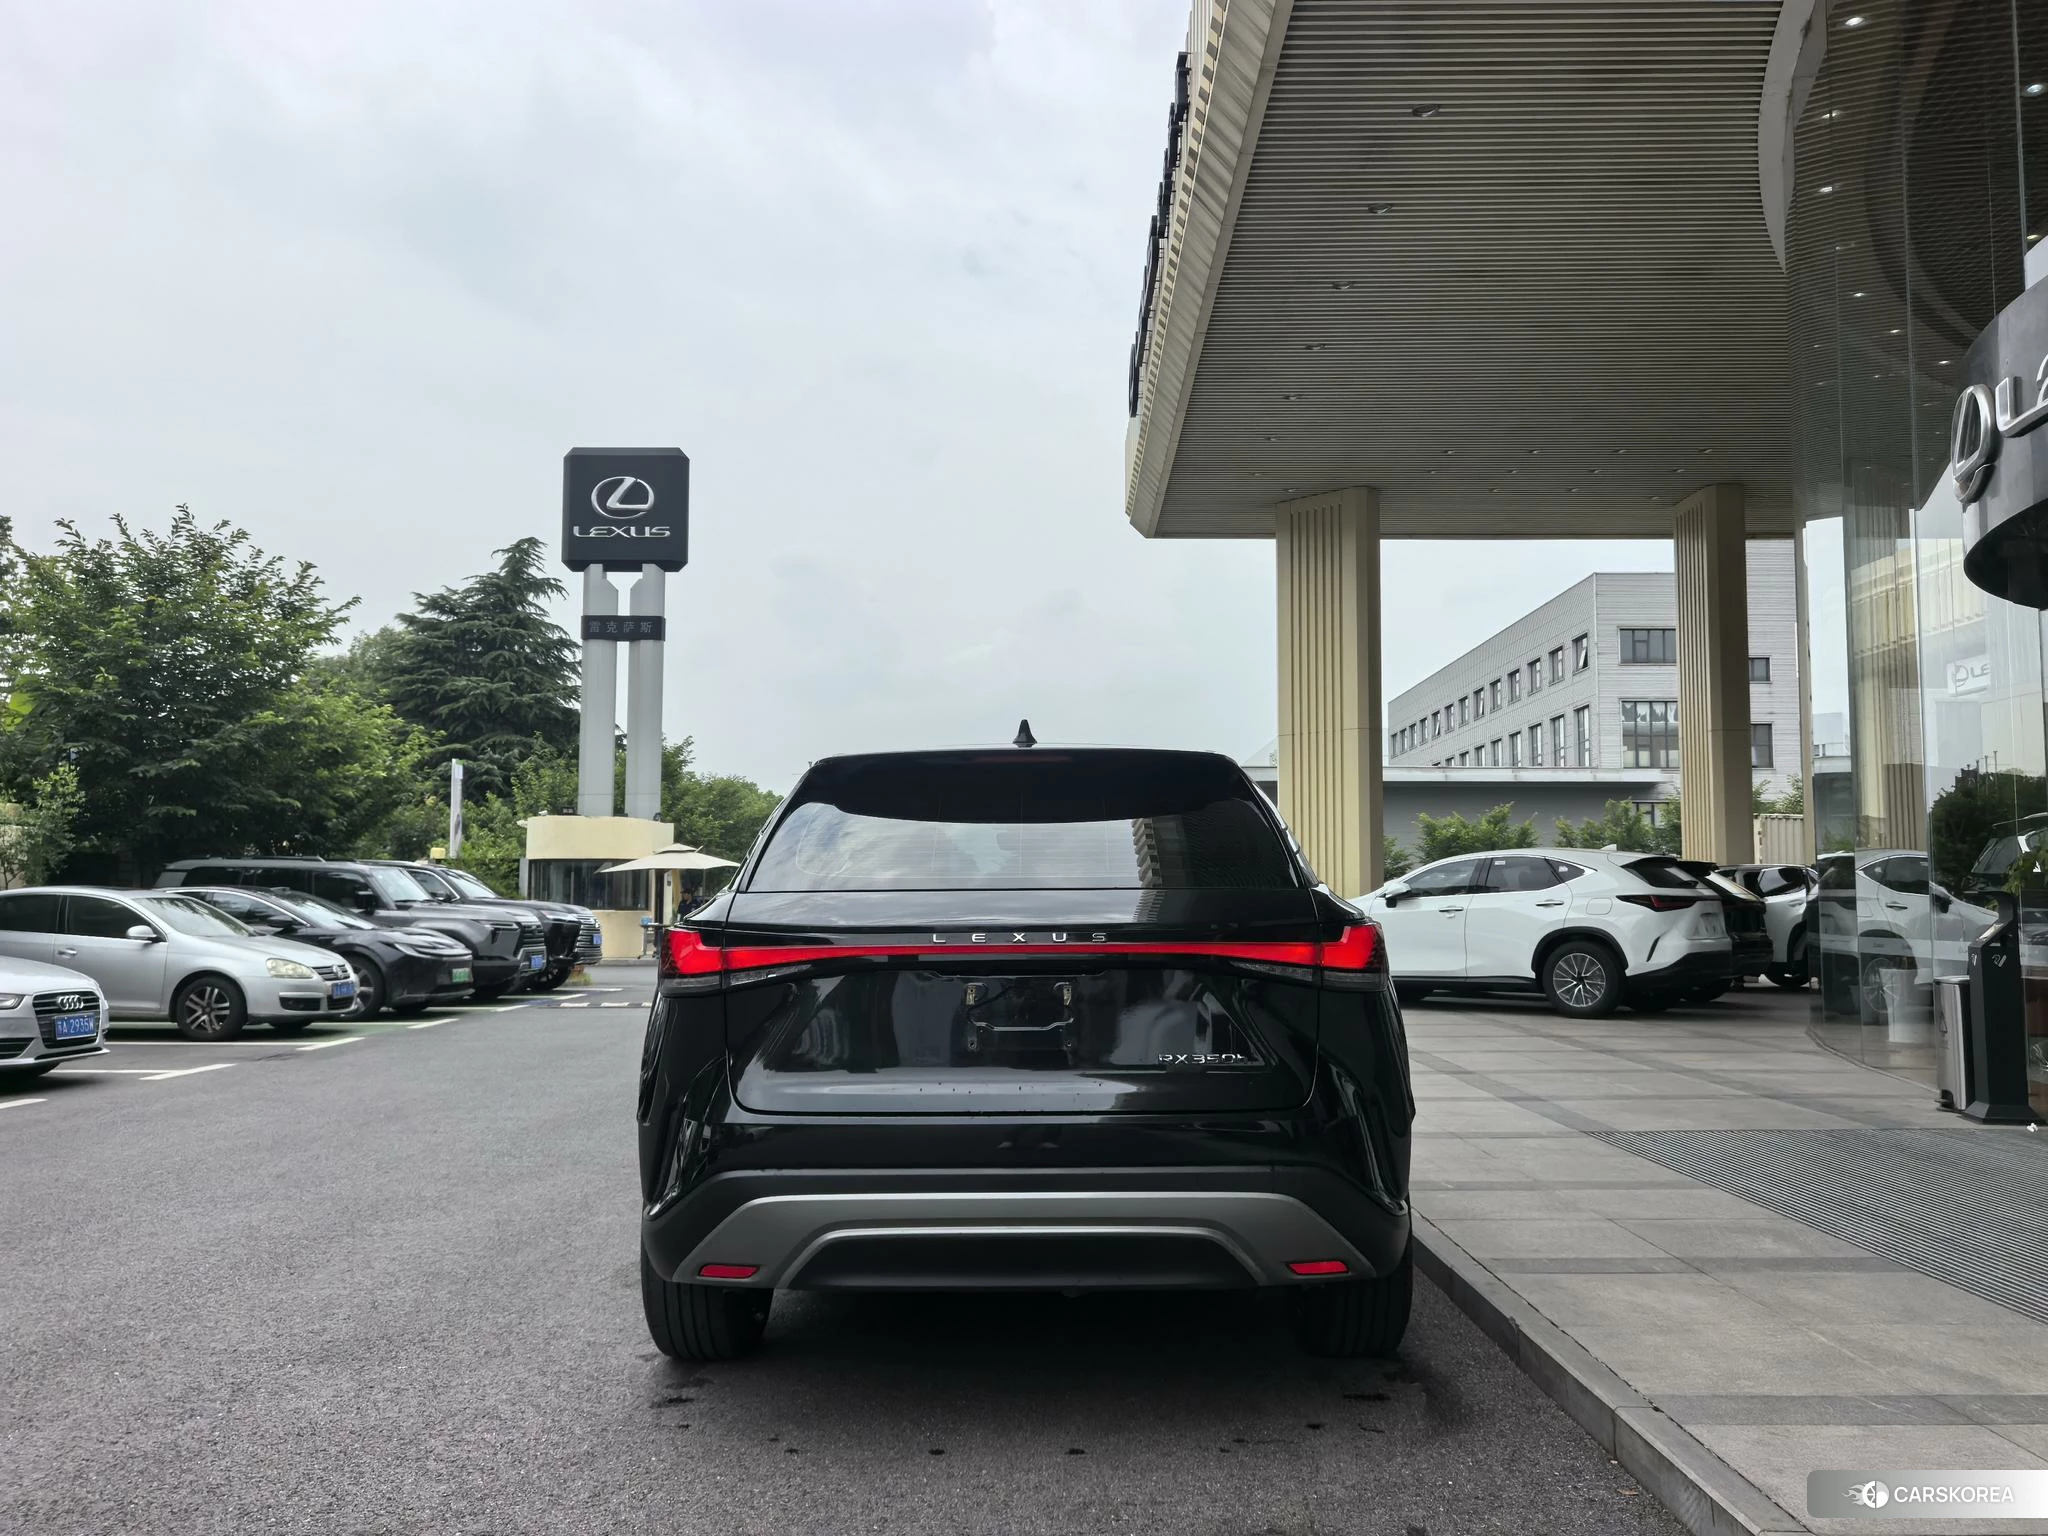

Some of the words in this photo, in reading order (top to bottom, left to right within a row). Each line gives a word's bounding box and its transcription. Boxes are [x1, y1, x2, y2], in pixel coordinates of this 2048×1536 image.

[573, 525, 671, 538] LEXUS
[588, 620, 653, 634] 雷克萨斯
[932, 932, 1107, 943] LEXUS
